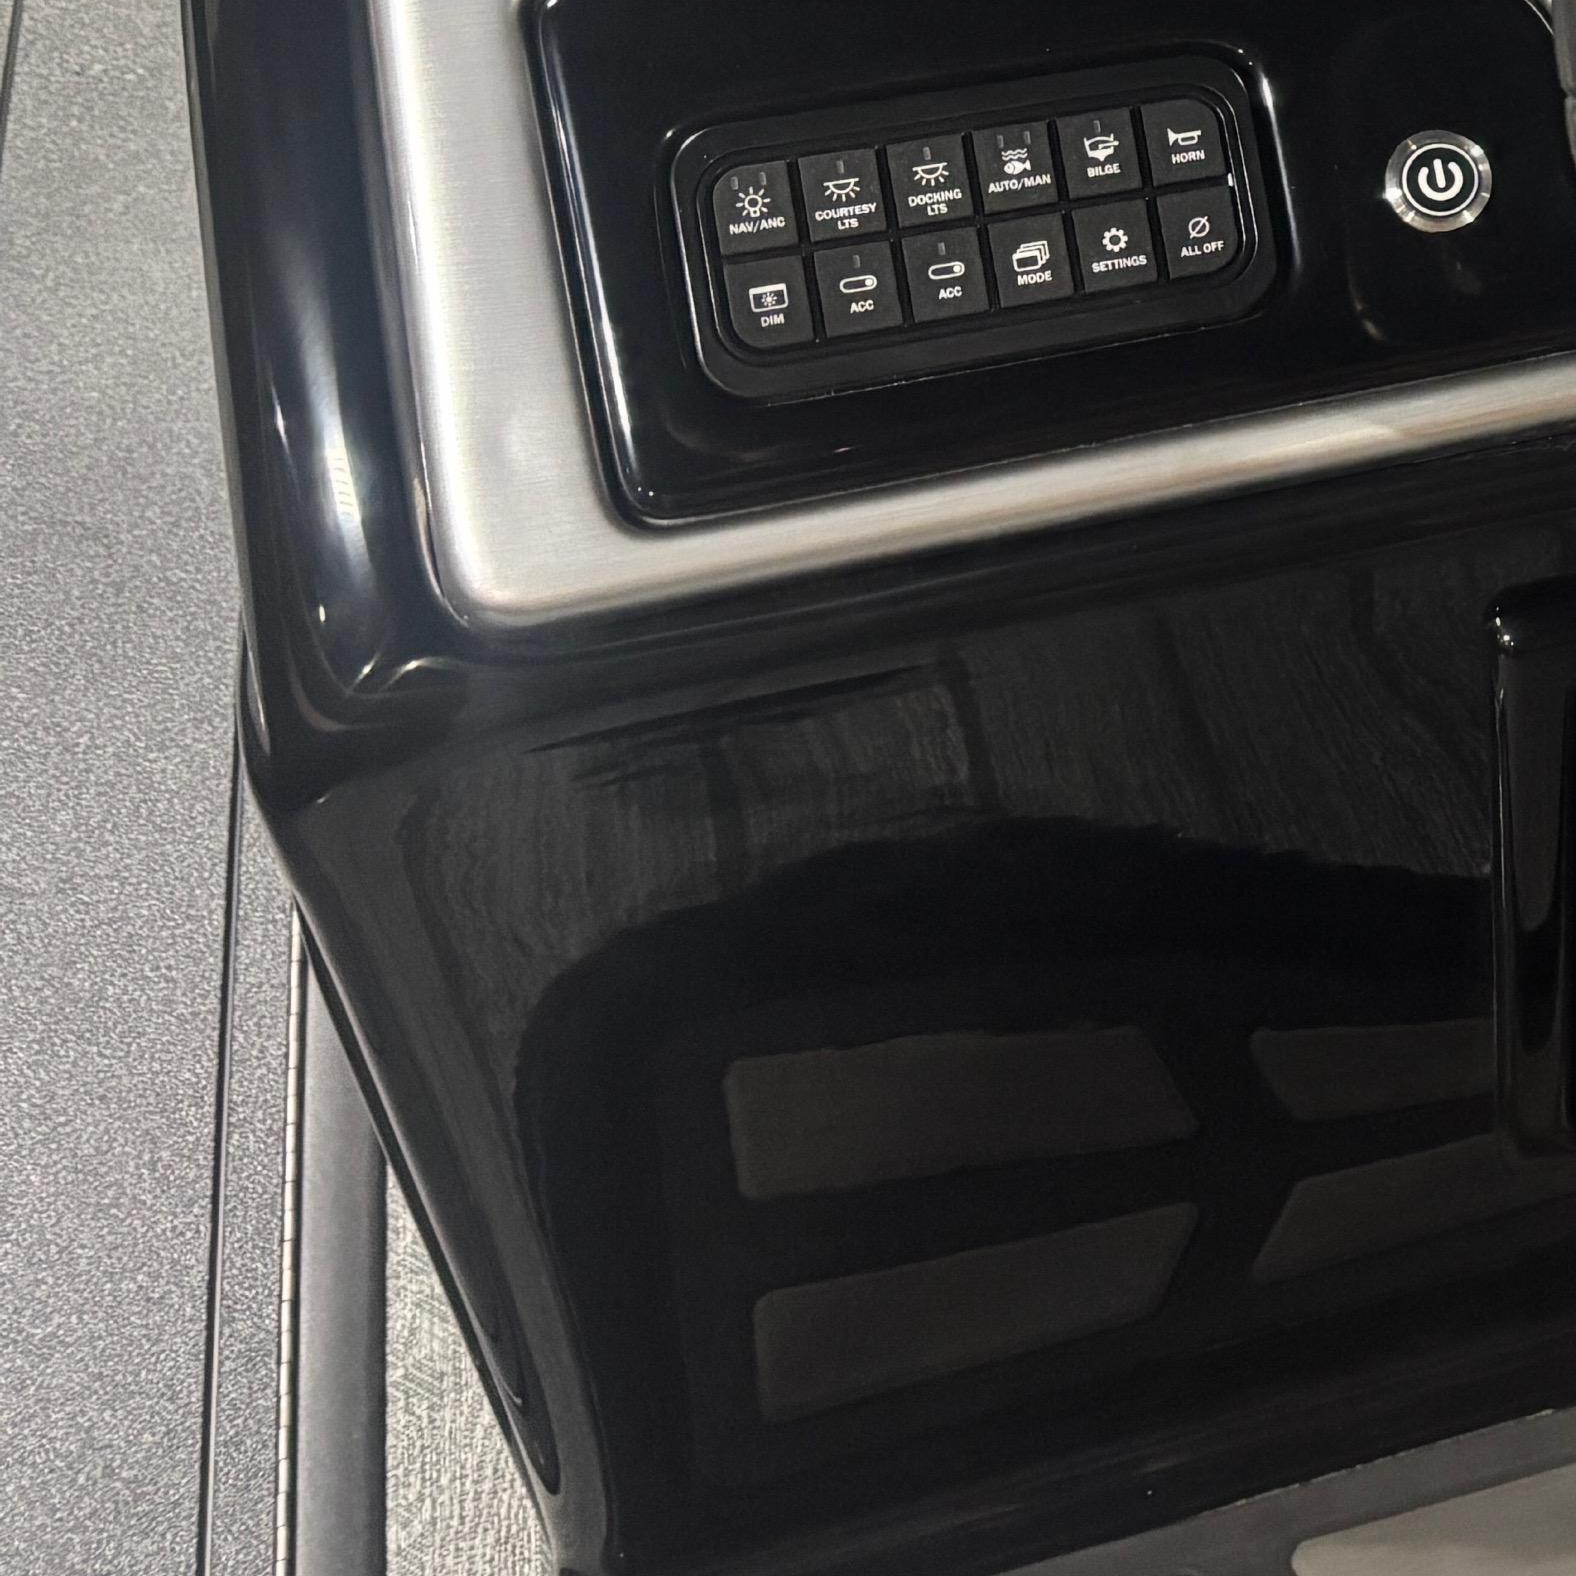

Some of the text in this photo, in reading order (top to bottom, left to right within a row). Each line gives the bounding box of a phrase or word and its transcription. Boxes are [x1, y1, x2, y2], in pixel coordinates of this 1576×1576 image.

[1172, 150, 1205, 164] HORN
[1087, 163, 1120, 177] BILGE
[989, 174, 1051, 193] AUTO/MAN
[908, 189, 962, 207] DOCKING
[815, 202, 876, 222] COURTESY
[925, 203, 947, 215] LTS
[836, 216, 858, 230] LTS
[1181, 241, 1224, 257] ALL OFF
[1092, 255, 1147, 272] SETTINGS
[1015, 269, 1052, 285] MODE
[939, 286, 962, 299] ACC
[850, 300, 874, 313] ACC
[761, 313, 784, 327] DIM
